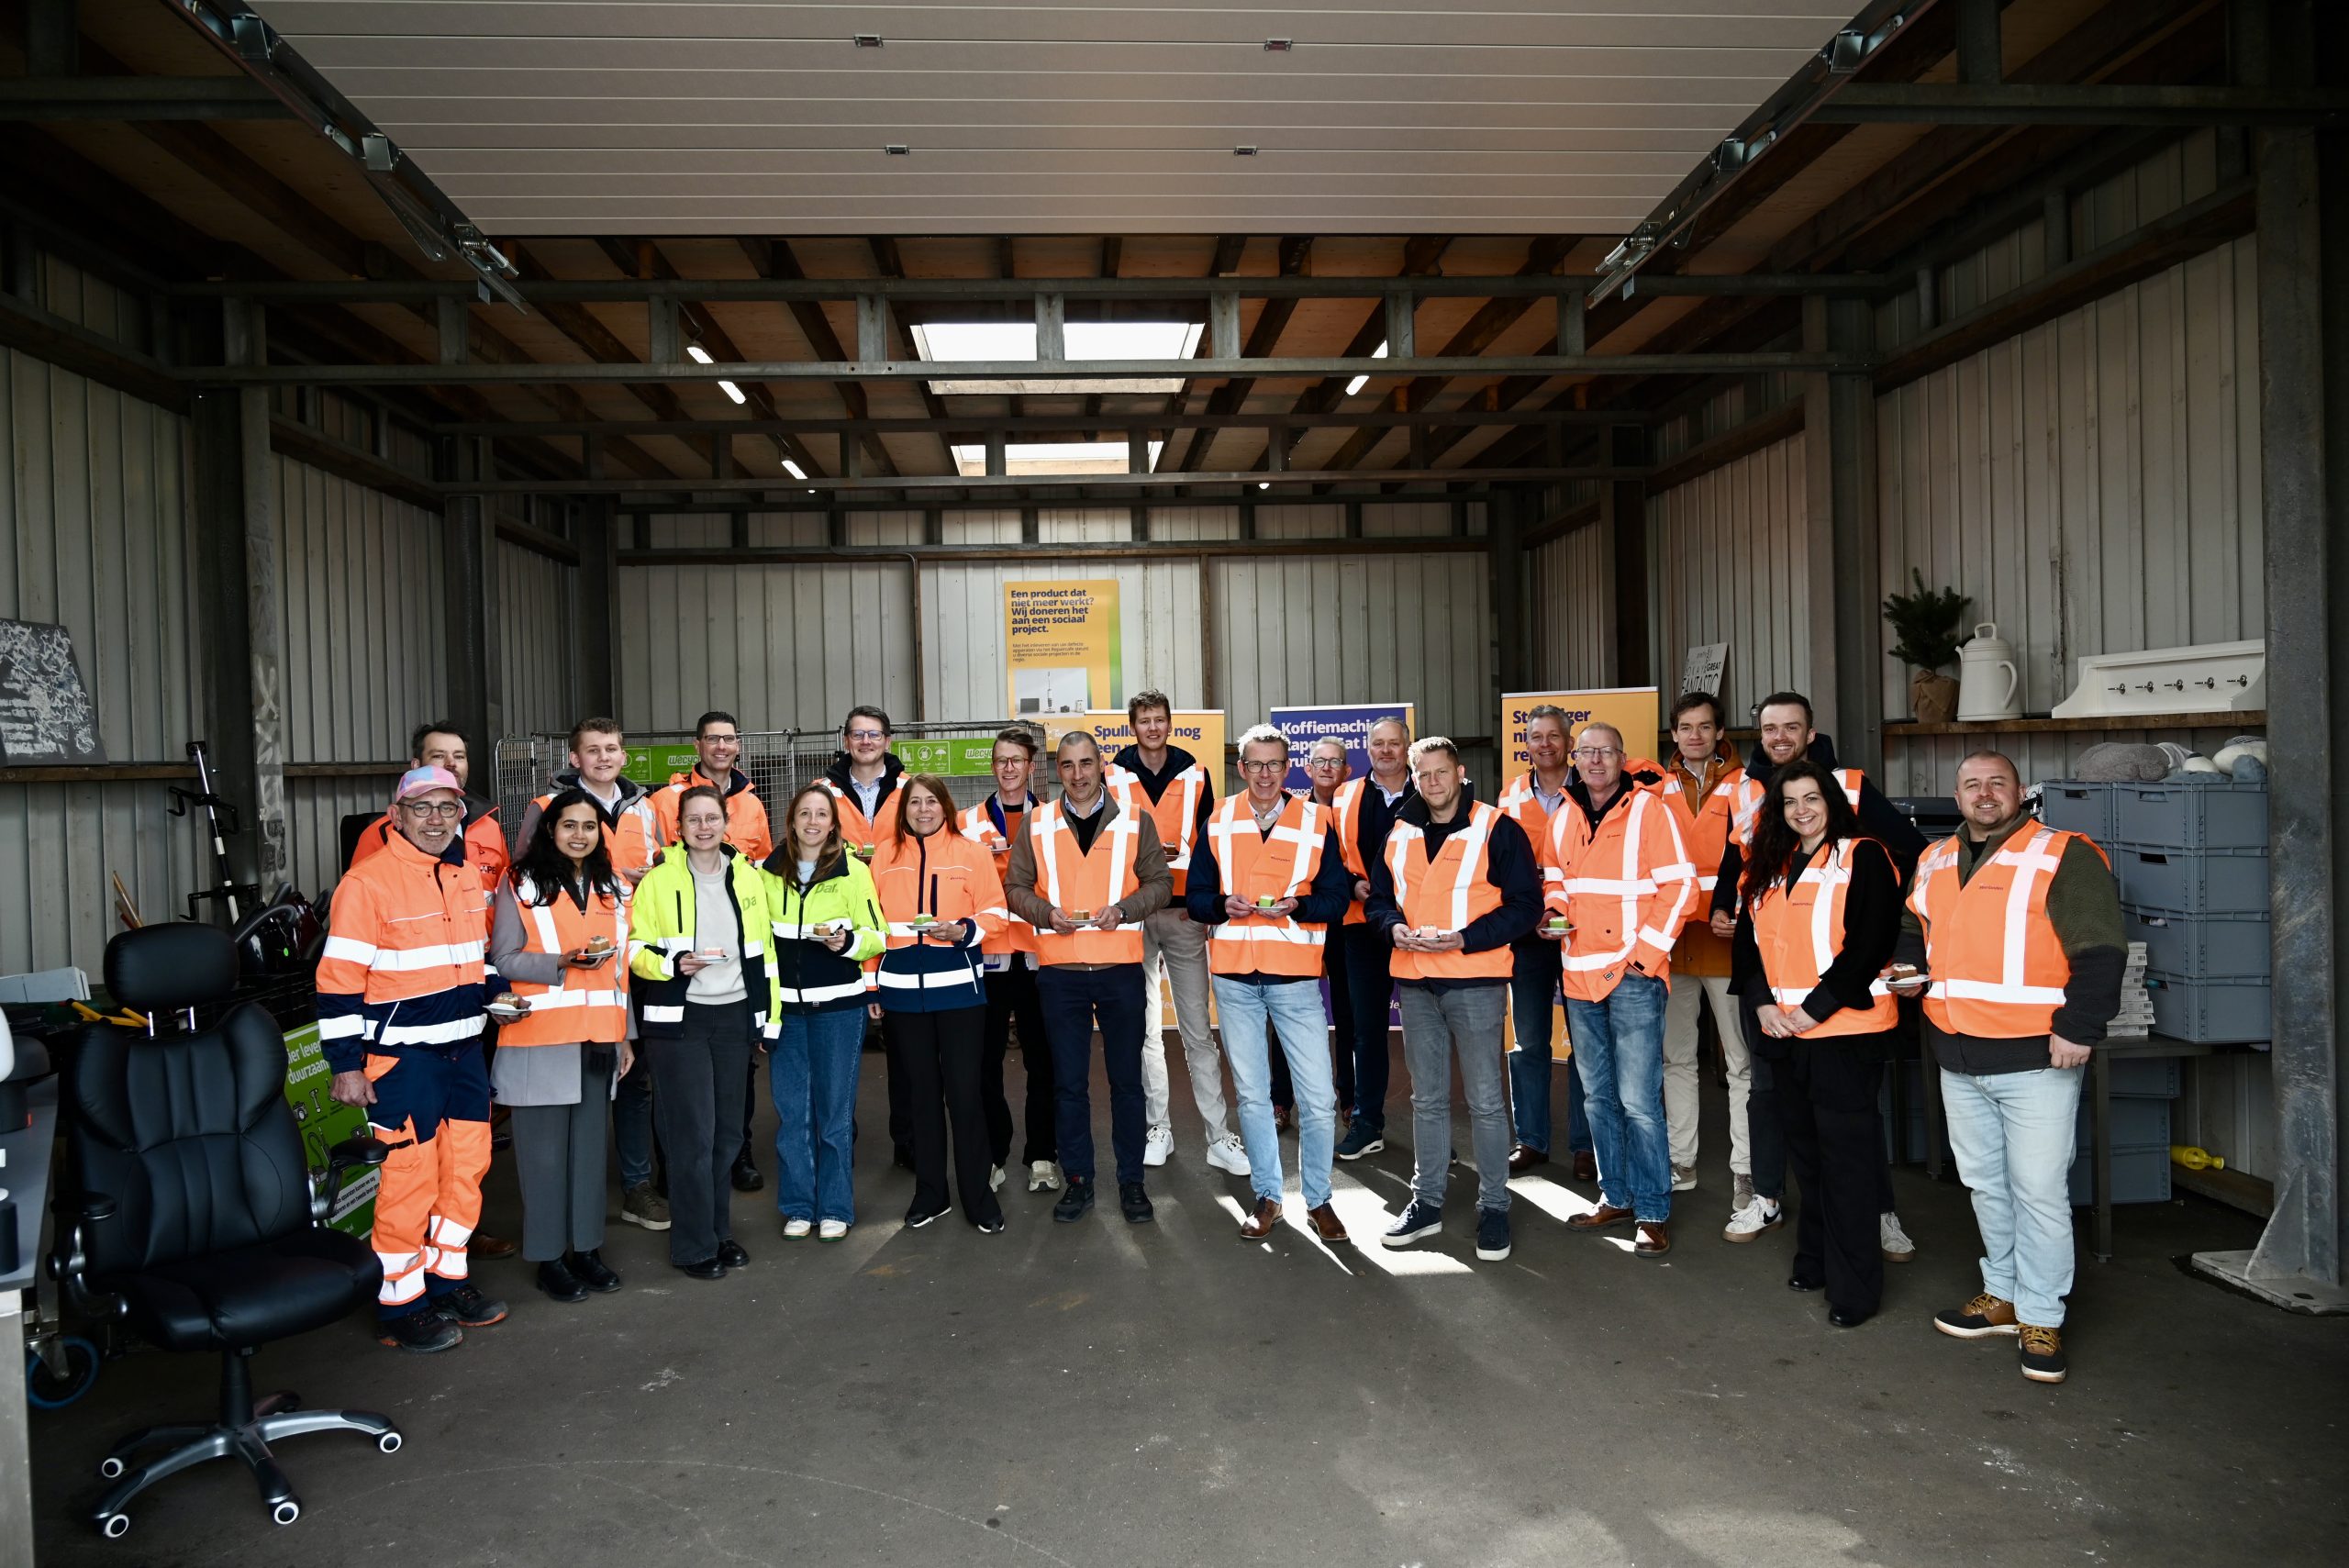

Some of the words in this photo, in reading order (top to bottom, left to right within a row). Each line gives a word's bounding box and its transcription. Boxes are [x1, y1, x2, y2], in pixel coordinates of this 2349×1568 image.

[1030, 589, 1069, 600] product
[1070, 589, 1086, 597] dat
[1060, 597, 1094, 606] werkt?
[1012, 607, 1027, 617] Wij
[1029, 607, 1070, 616] doneren
[1052, 615, 1085, 623] sociaal
[1012, 625, 1049, 635] project.
[1281, 719, 1371, 735] Koffiemachi
[1174, 726, 1201, 740] nog
[287, 1048, 301, 1064] ier
[288, 1059, 329, 1085] duurzaam
